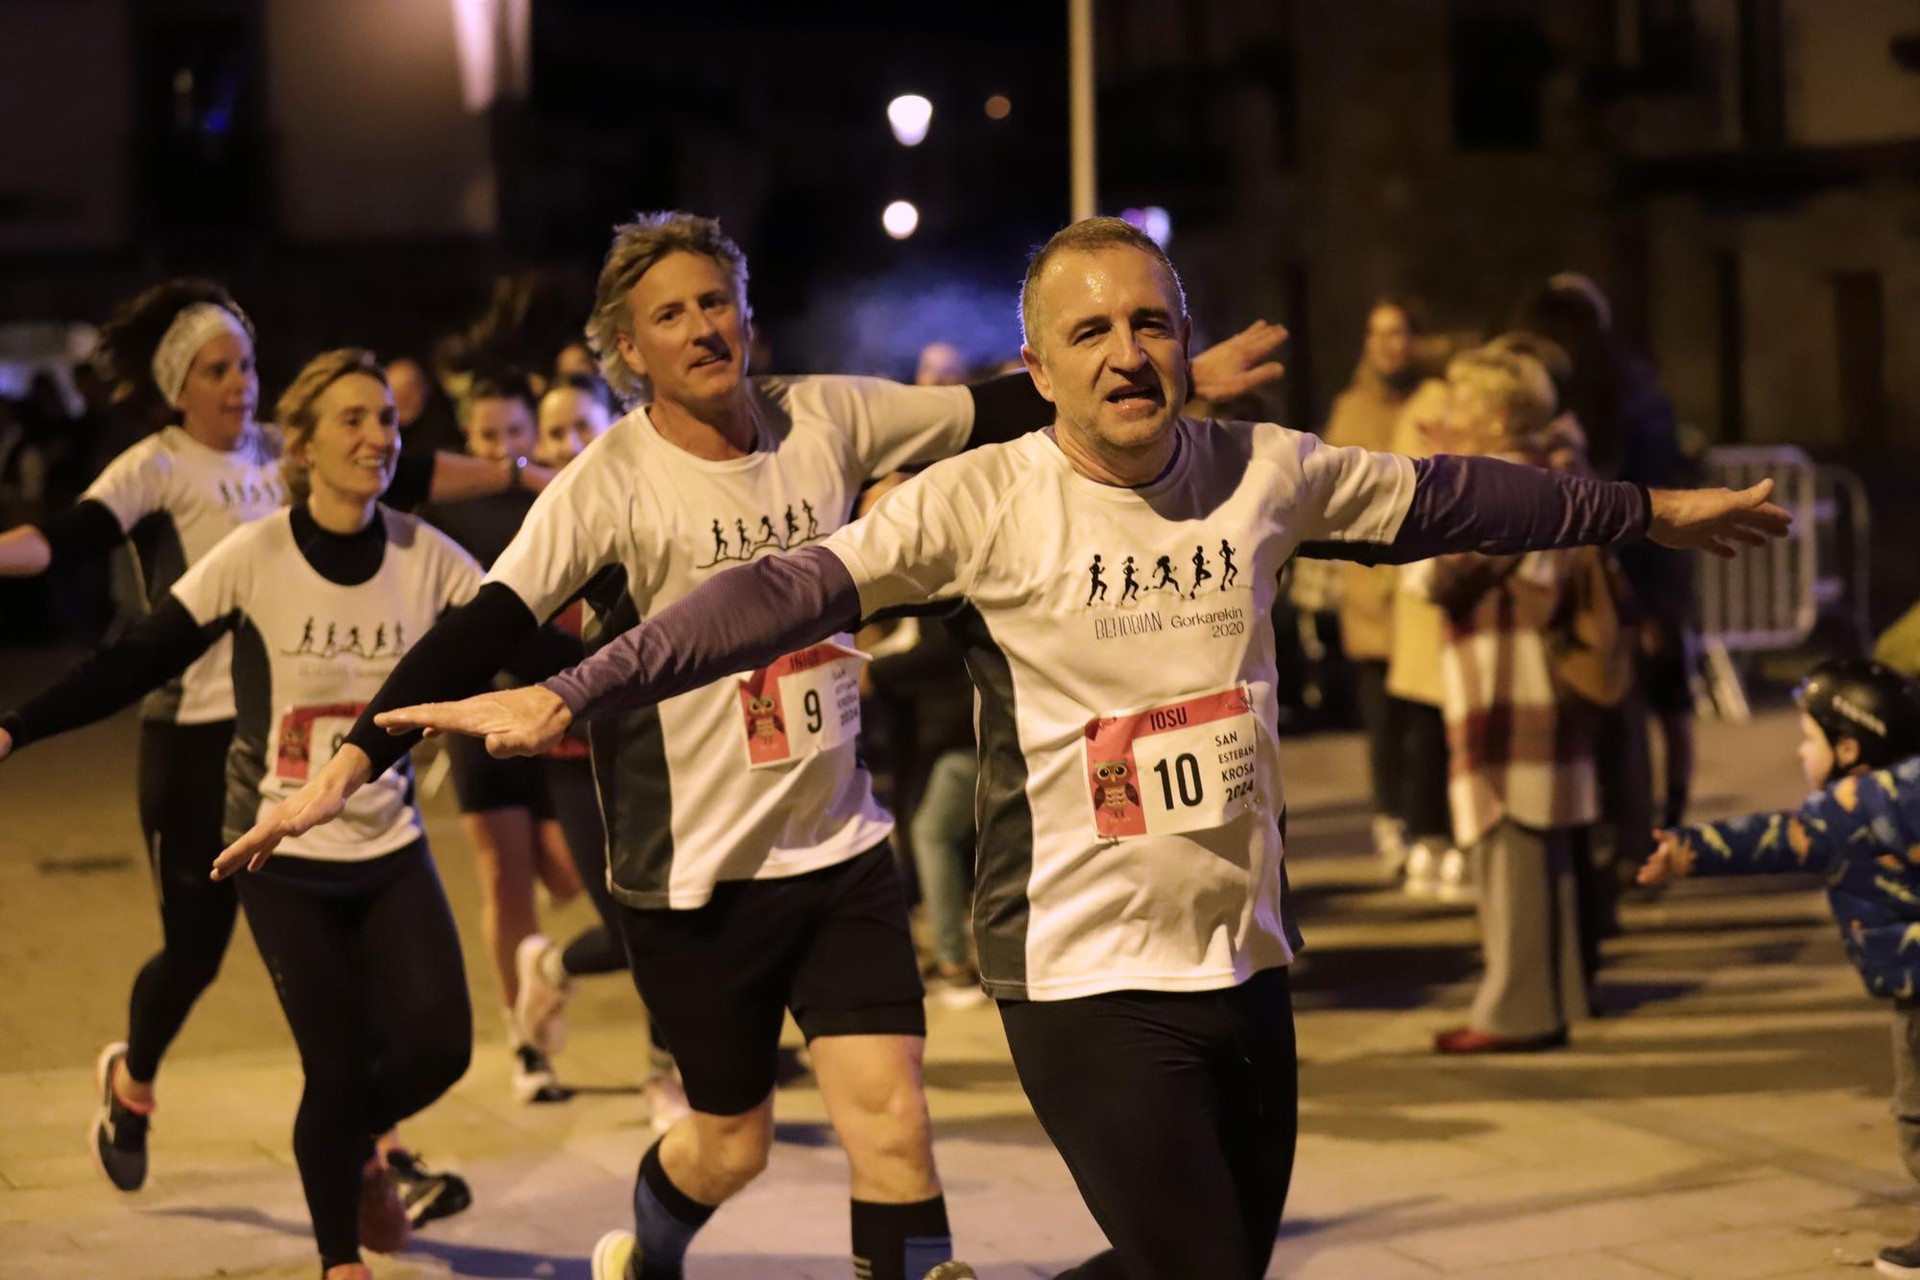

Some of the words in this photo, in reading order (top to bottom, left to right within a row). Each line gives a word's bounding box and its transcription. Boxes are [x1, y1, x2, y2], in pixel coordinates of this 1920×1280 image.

[1170, 607, 1243, 629] Gorkarekin
[1212, 621, 1244, 638] 2020
[804, 689, 823, 734] 9
[1150, 706, 1188, 731] IOSU
[1214, 730, 1238, 747] SAN
[1218, 744, 1254, 764] ESTEBAN
[1153, 752, 1204, 811] 10
[1221, 761, 1255, 783] KROSA
[1225, 778, 1254, 803] 2024
